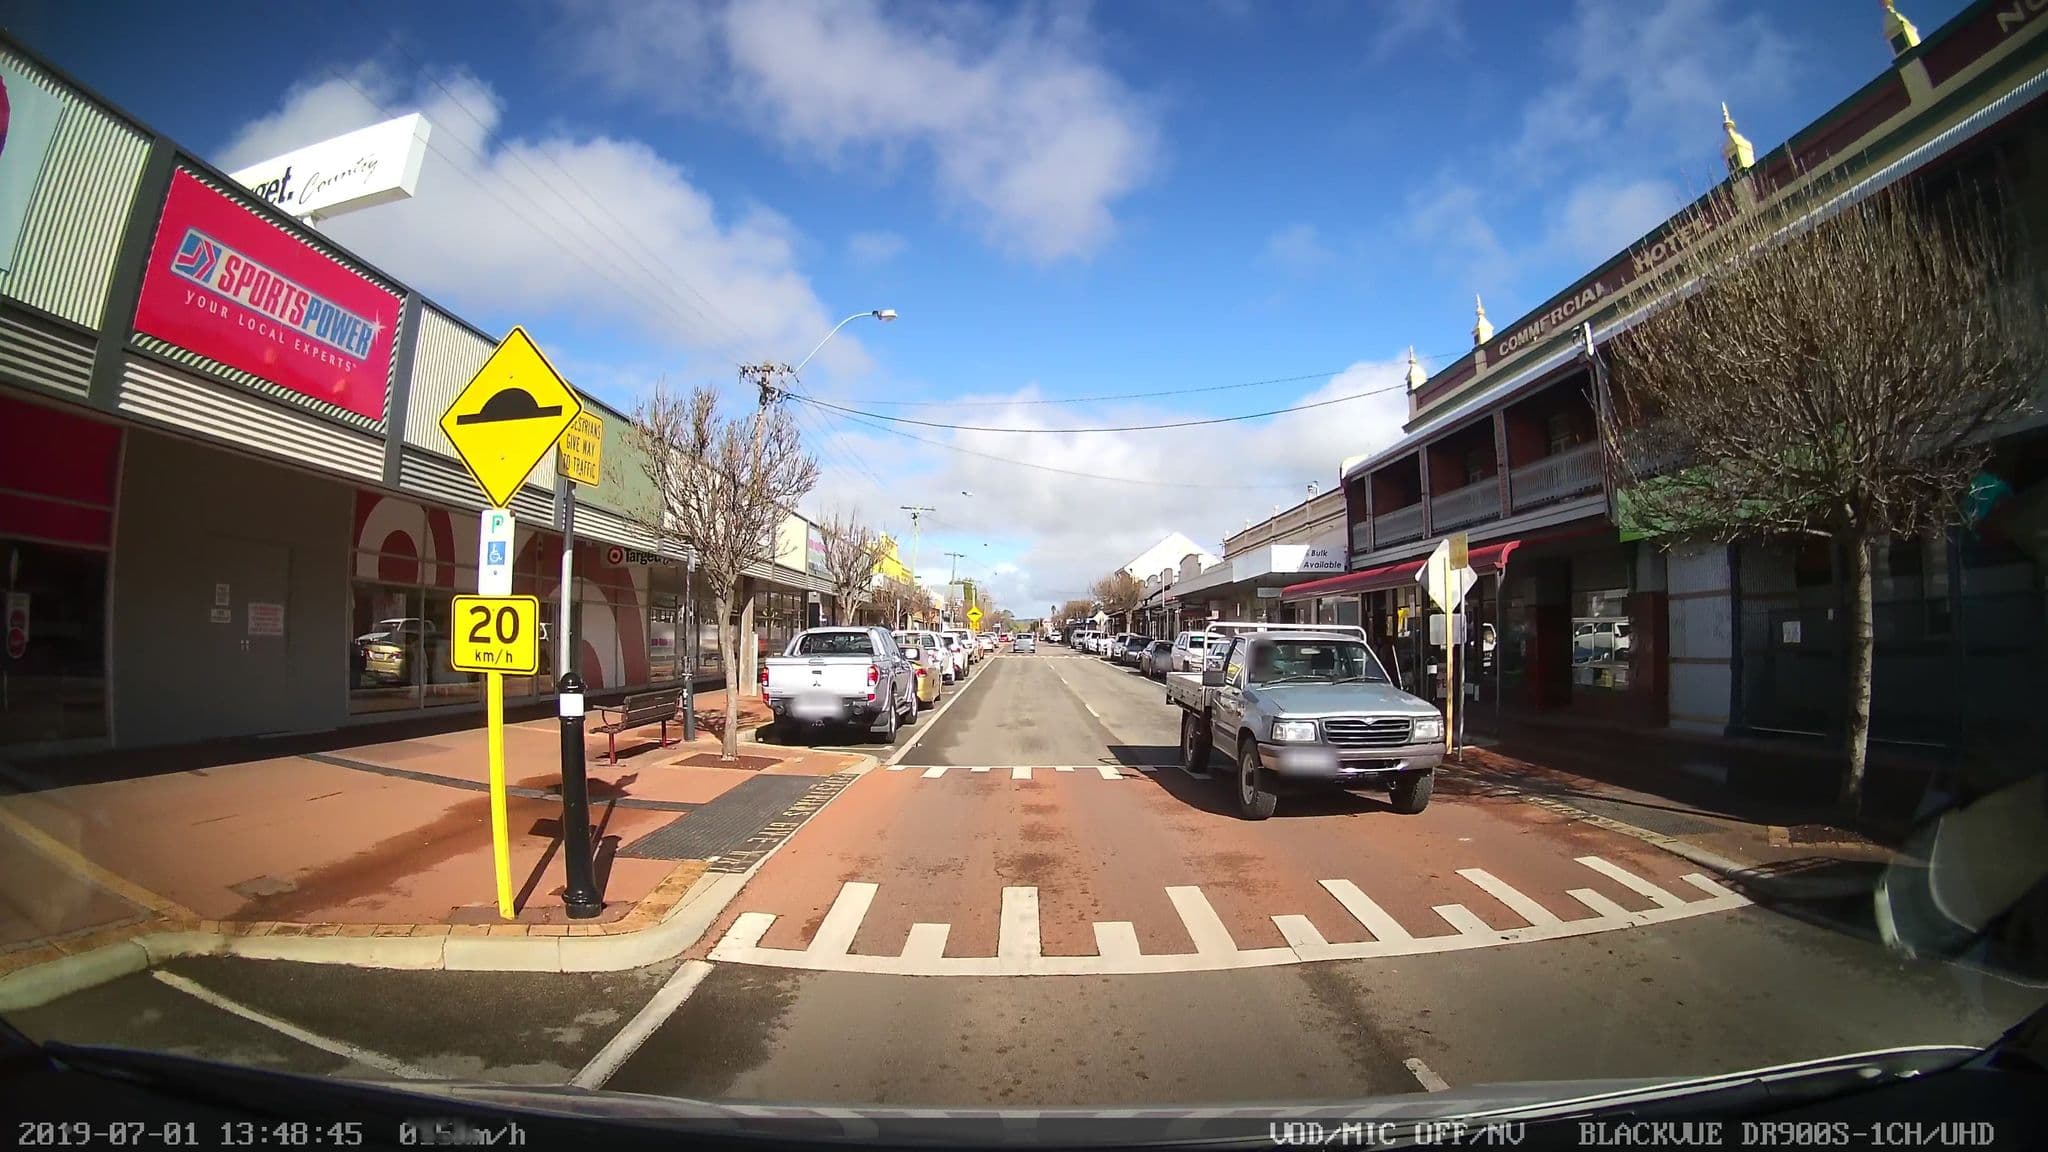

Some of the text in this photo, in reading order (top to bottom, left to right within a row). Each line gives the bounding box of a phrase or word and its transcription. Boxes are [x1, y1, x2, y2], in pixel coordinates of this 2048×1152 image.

[217, 253, 374, 357] SPORTSPOWER
[185, 289, 352, 374] YOUR LOCAL EXPERTS
[566, 433, 596, 457] GIVE WAY
[563, 453, 596, 479] TO TRAFFIC
[491, 514, 504, 533] P
[1303, 561, 1342, 569] Available
[1311, 549, 1328, 557] Bulk
[468, 605, 520, 645] 20
[474, 649, 513, 665] km/h
